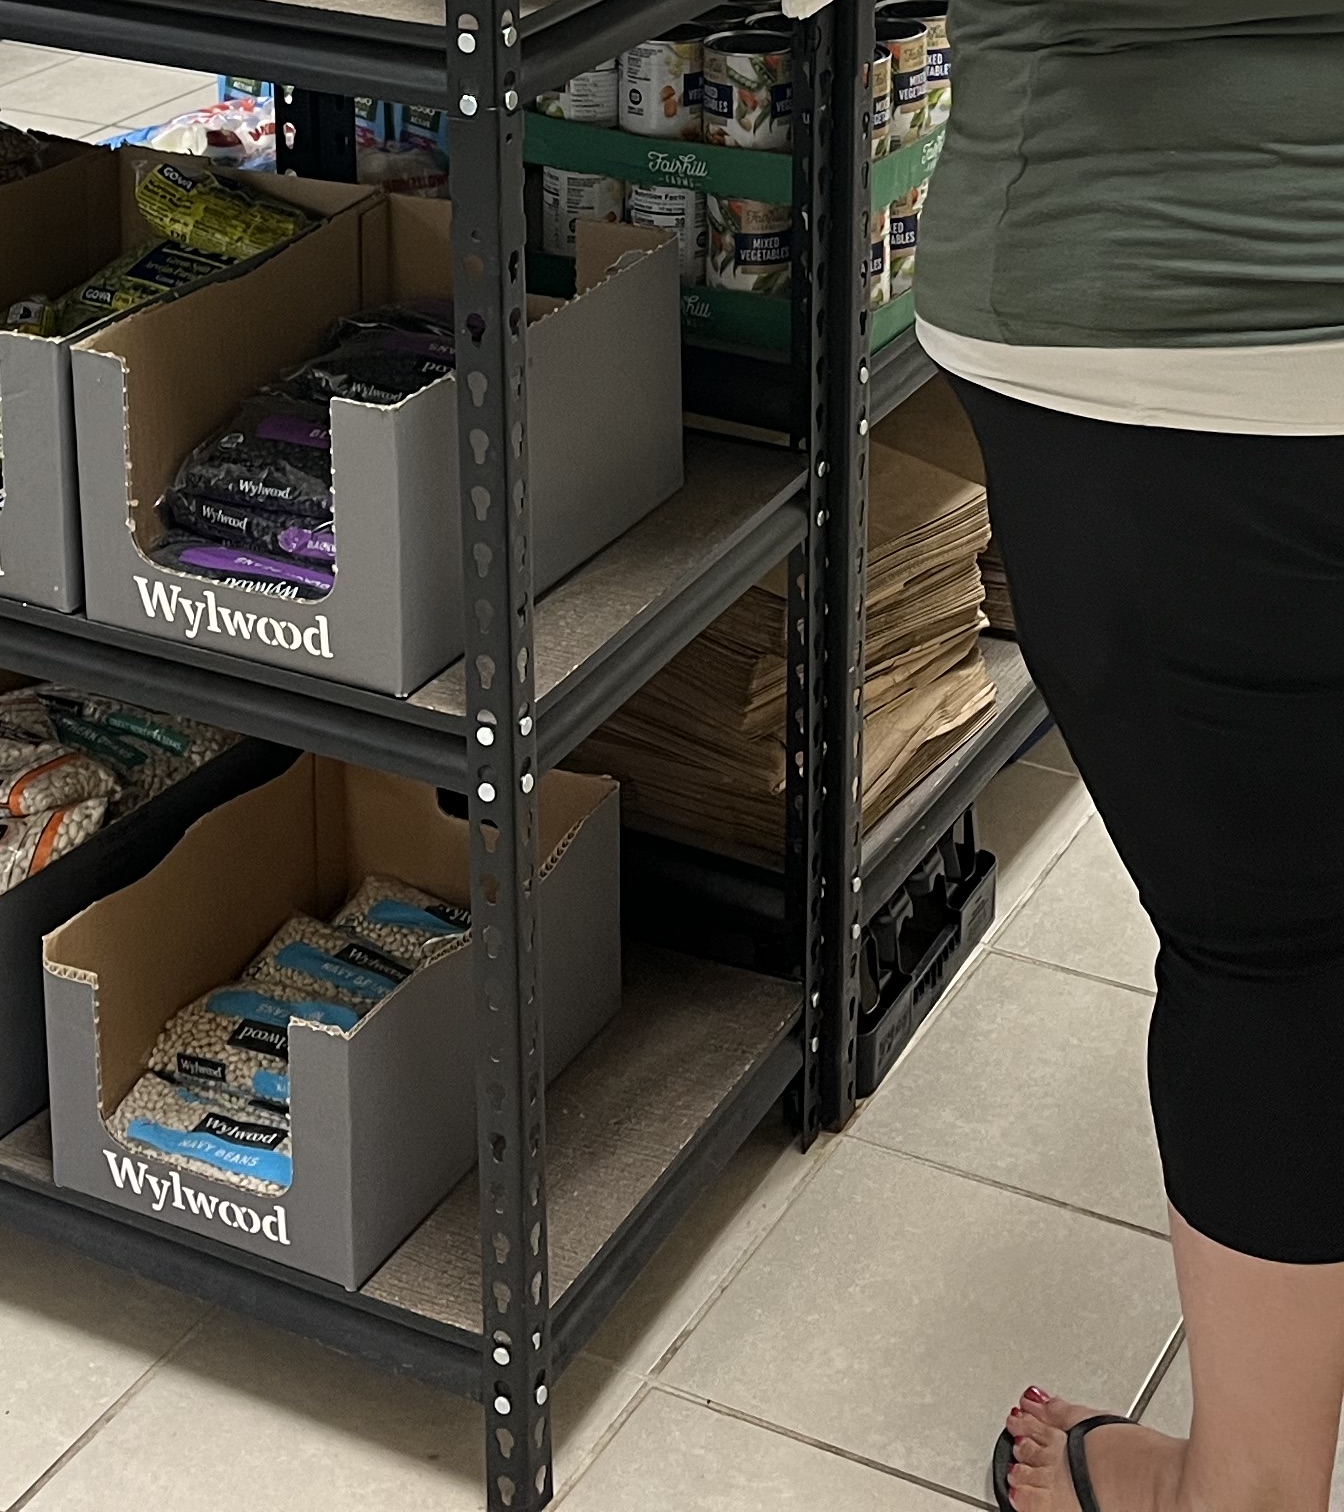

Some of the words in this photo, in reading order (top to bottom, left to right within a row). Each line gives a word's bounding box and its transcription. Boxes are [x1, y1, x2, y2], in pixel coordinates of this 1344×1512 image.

[648, 151, 707, 177] Fairhill
[163, 166, 193, 190] GOYA
[739, 246, 790, 261] VEGETABLES
[752, 238, 780, 249] MIXED
[85, 289, 111, 303] GOYA
[239, 479, 291, 502] Wylwood
[202, 504, 248, 531] Wylwood
[133, 575, 333, 659] Wylwood
[180, 1059, 223, 1079] Wylwood
[206, 1117, 278, 1144] Wylwood
[178, 1138, 212, 1153] NAVY
[214, 1148, 260, 1167] BEANS
[102, 1148, 291, 1246] Wylwood
